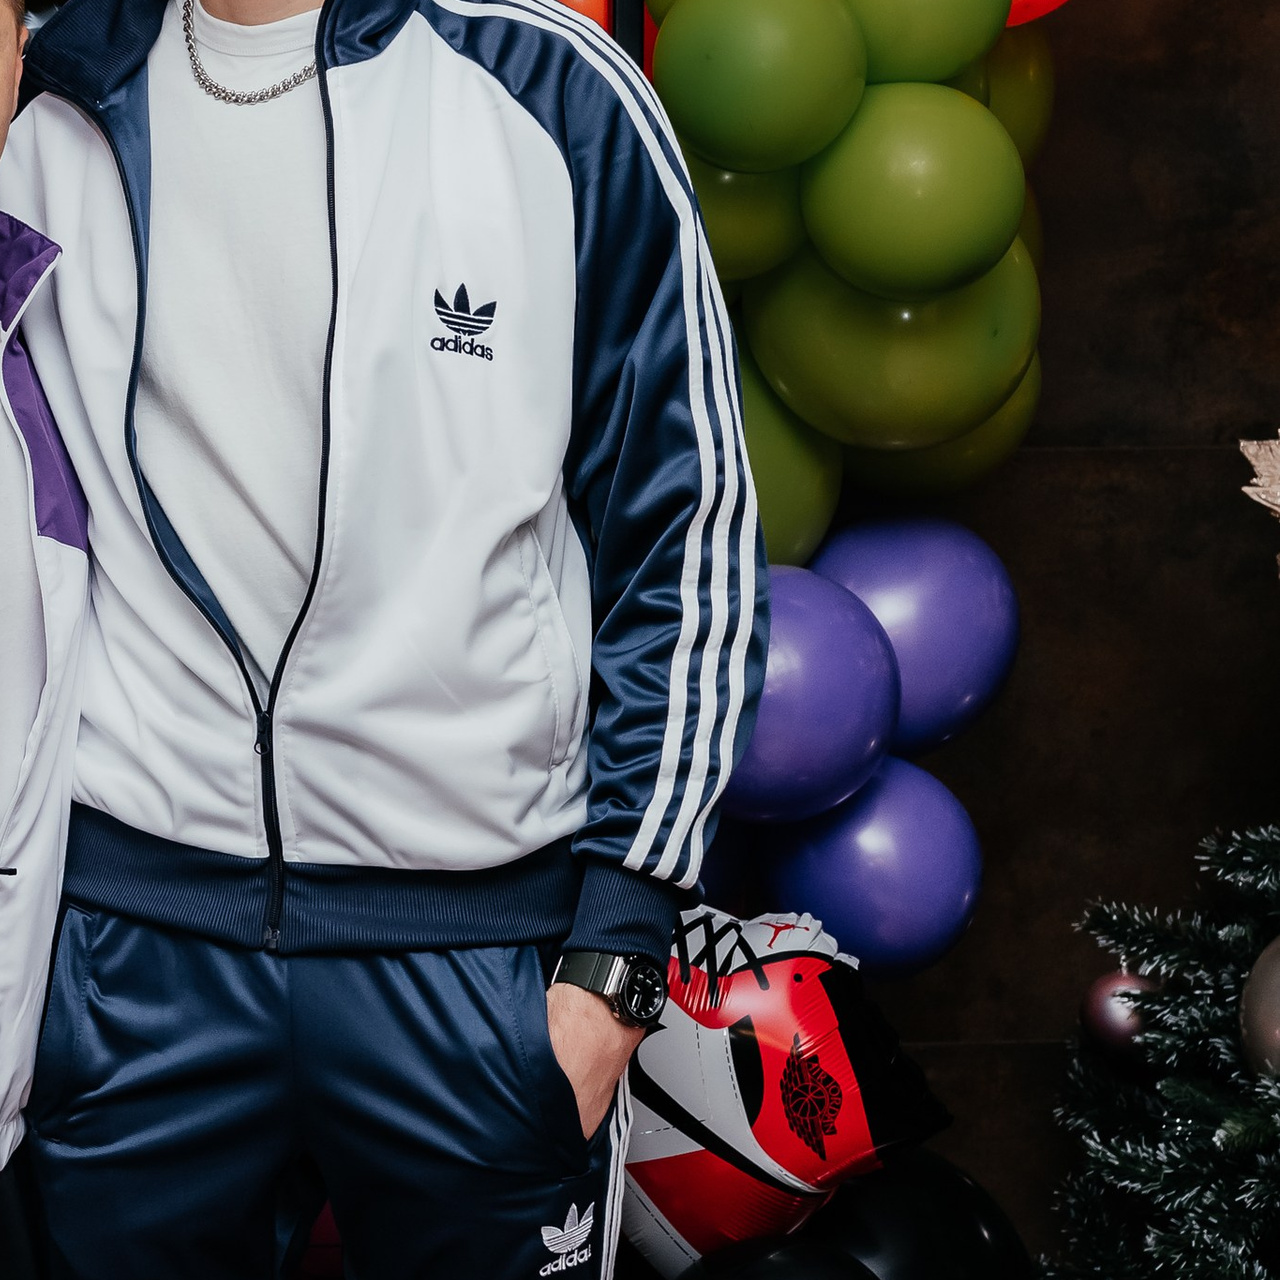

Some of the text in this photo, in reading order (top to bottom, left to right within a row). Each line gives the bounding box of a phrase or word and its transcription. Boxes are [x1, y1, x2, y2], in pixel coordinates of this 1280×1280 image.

[430, 335, 494, 361] adidas
[807, 1061, 842, 1133] AIR JORDAN
